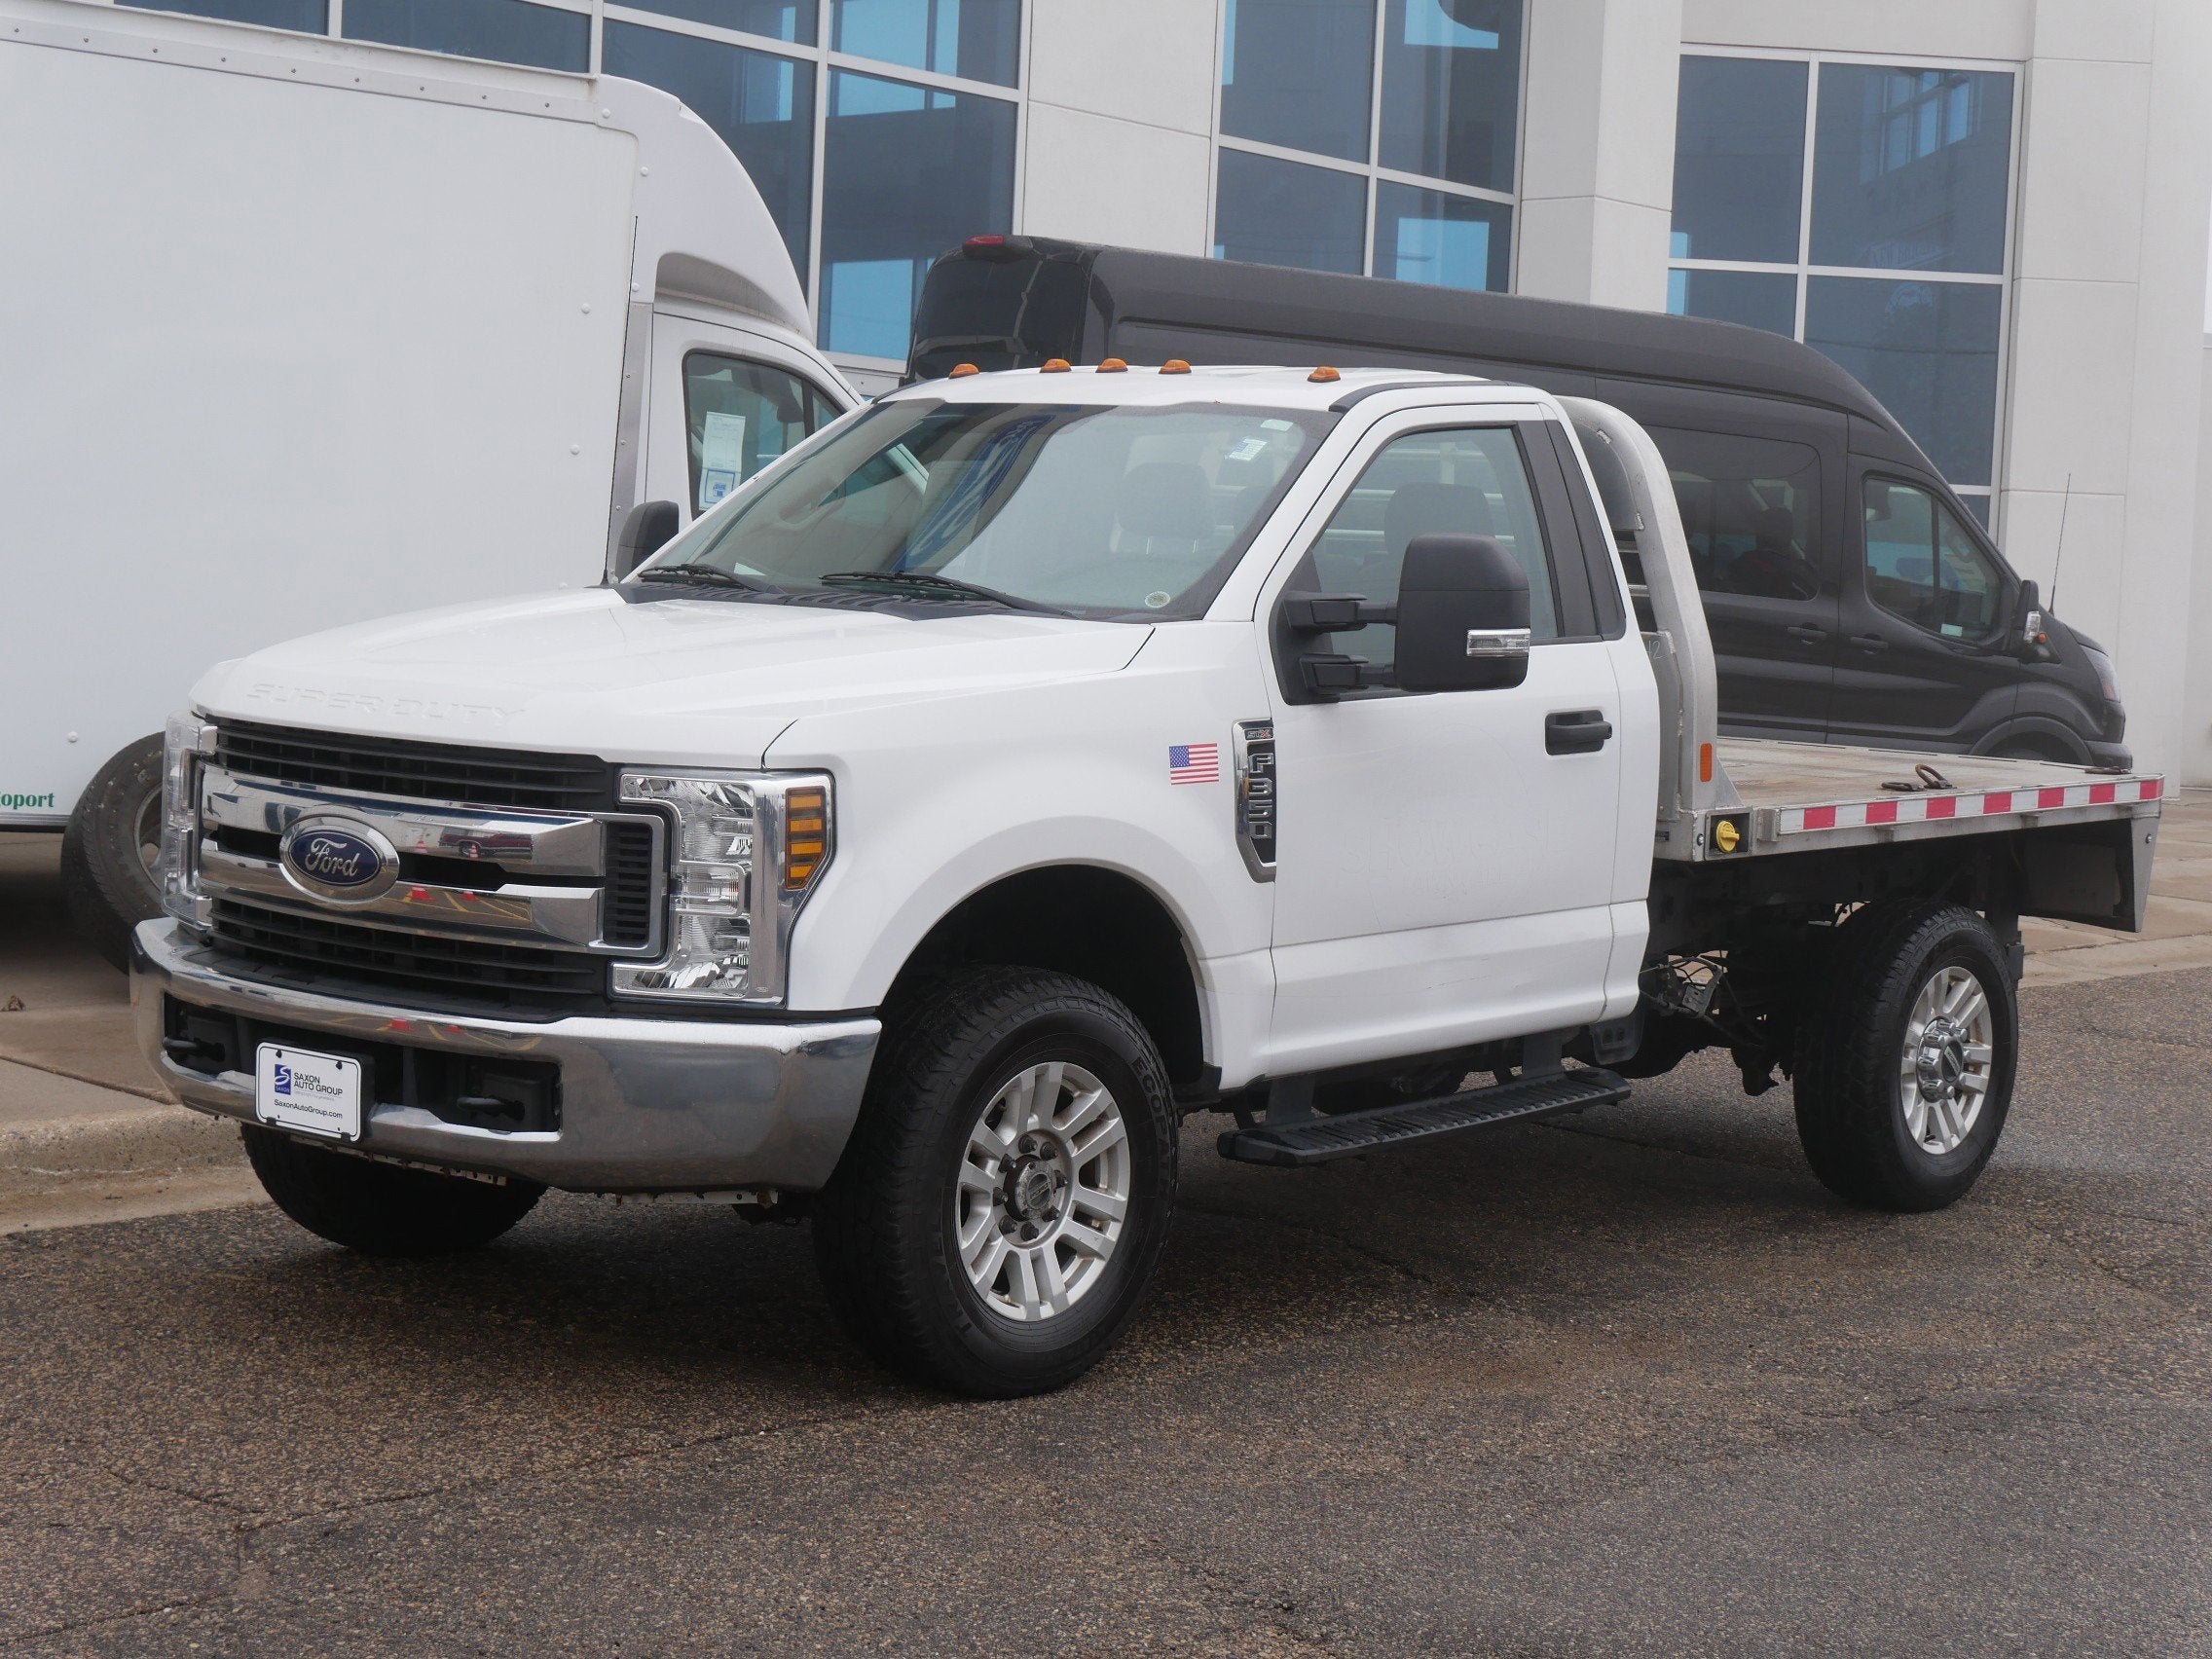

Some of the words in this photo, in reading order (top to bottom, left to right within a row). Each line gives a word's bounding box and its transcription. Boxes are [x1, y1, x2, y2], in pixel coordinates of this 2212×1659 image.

[245, 682, 385, 713] SUPER
[390, 697, 527, 725] DUTY
[0, 791, 55, 810] oport
[305, 837, 360, 877] Ford
[293, 1072, 320, 1085] SAXON
[293, 1081, 314, 1091] AUTO
[315, 1084, 344, 1096] GROUP
[274, 1099, 343, 1119] SaxonAutoGroup.com
